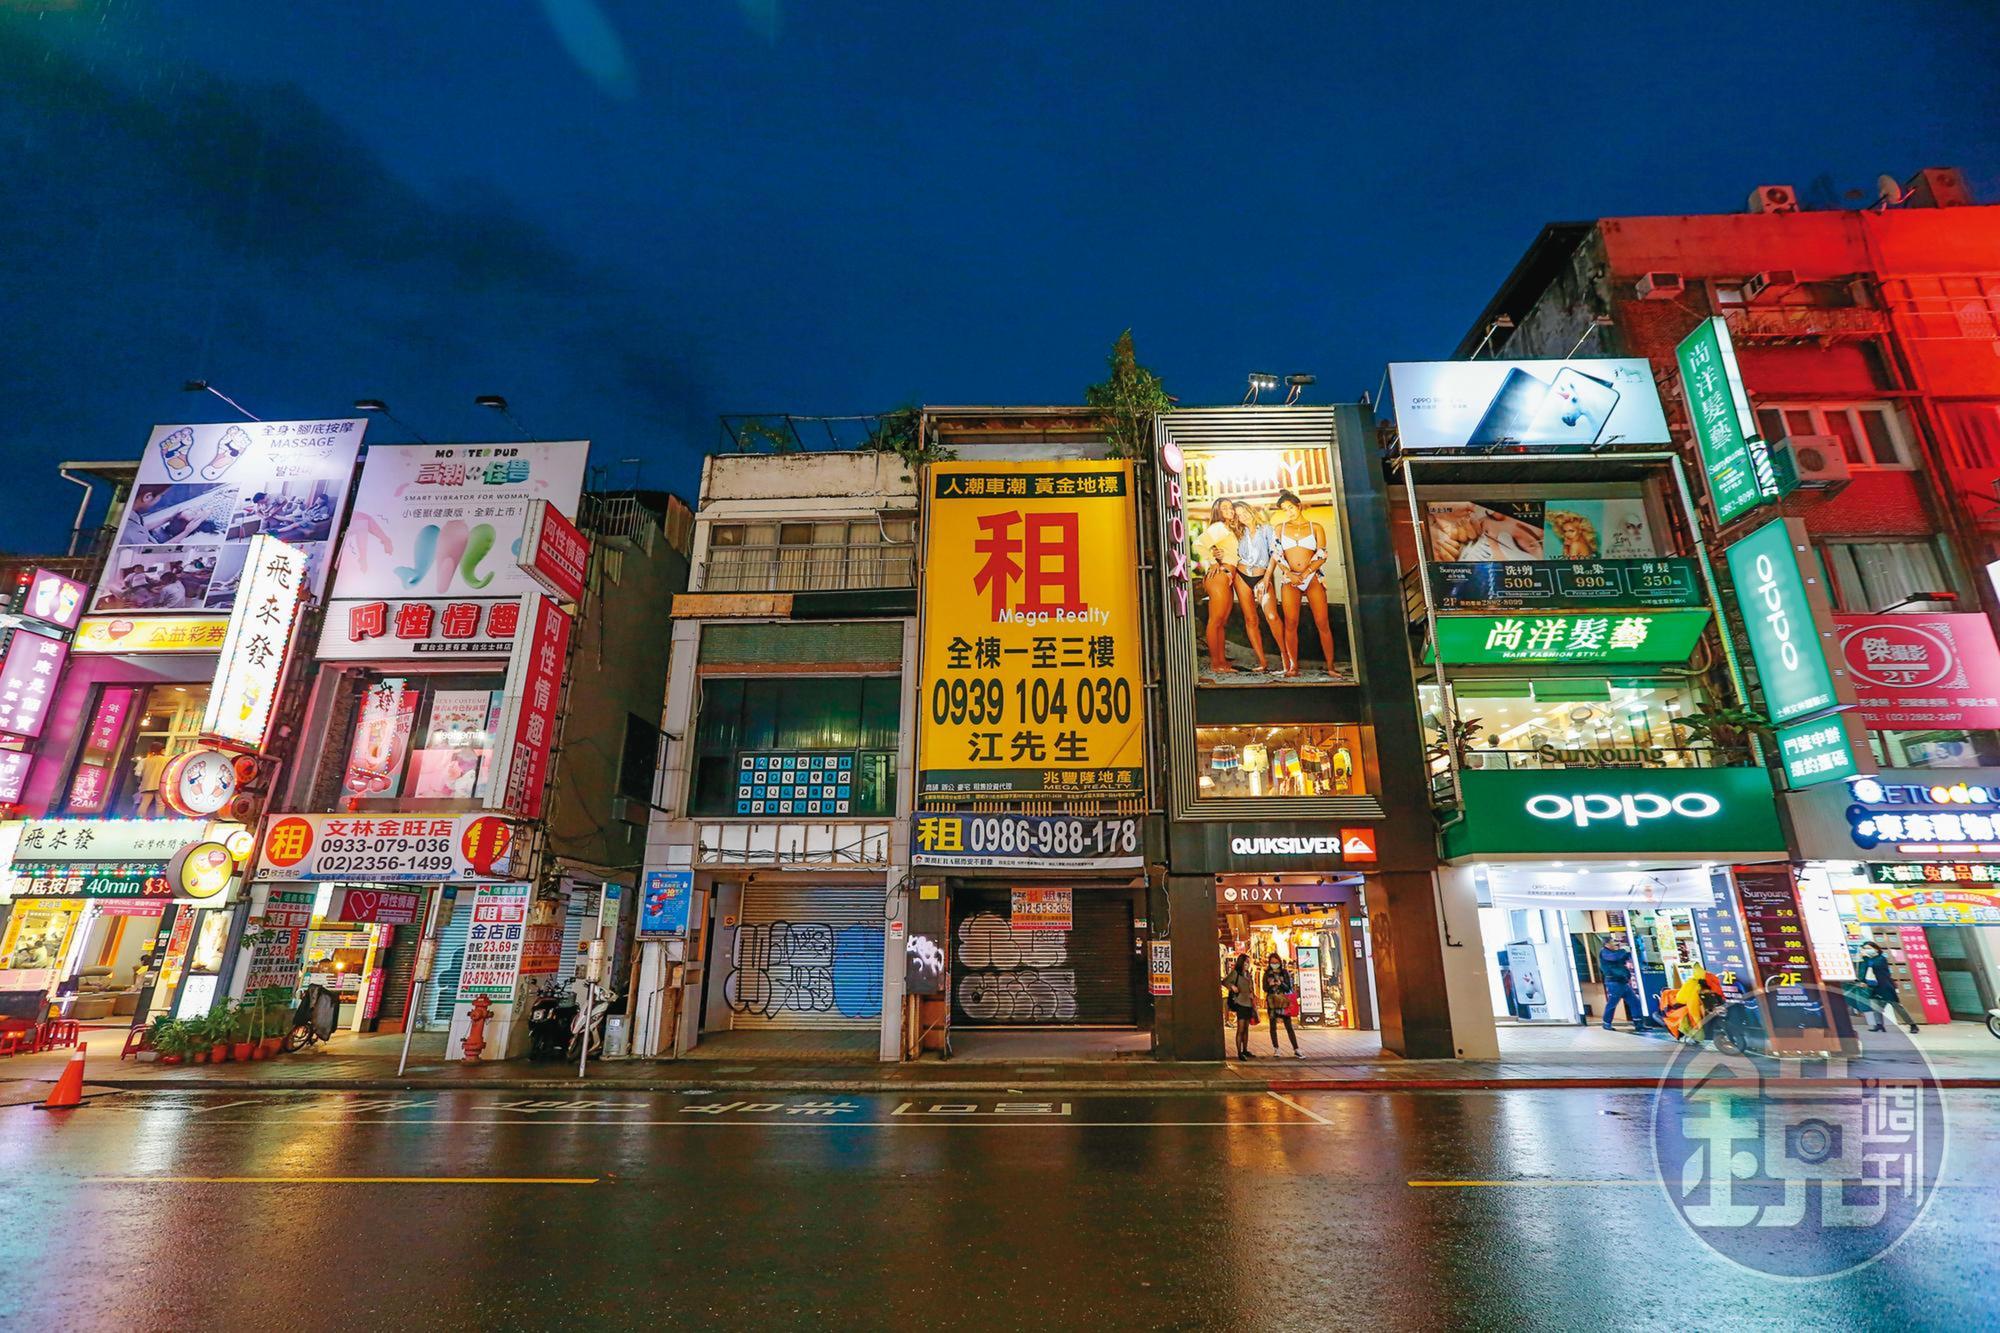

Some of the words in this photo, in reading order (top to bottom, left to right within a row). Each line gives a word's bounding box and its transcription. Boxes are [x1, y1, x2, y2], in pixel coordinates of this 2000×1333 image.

[1689, 340, 1732, 449] 尚洋髮藝
[270, 436, 336, 448] MASSAGE
[494, 448, 519, 457] PUB
[943, 477, 1027, 495] 人潮車潮
[1034, 476, 1119, 495] 黃金地標
[1167, 481, 1188, 618] ROXY
[973, 510, 1088, 622] 租
[1504, 578, 1533, 588] 500
[1575, 576, 1605, 588] 990
[1642, 576, 1673, 586] 350
[245, 555, 293, 669] 飛來發
[998, 608, 1049, 627] Mega
[1056, 607, 1110, 626] Realty
[349, 601, 519, 642] 阿性情趣
[150, 624, 226, 643] 公益彩券
[1485, 617, 1653, 650] 尚洋髮藝
[947, 635, 1115, 669] 全棟一至三樓
[525, 607, 563, 747] 阿性情趣
[1883, 671, 1920, 683] 2F
[932, 677, 1004, 725] 0939
[1016, 677, 1068, 724] 104
[1077, 677, 1131, 724] 030
[967, 730, 1090, 762] 江先生
[1539, 744, 1664, 767] Sunyoung
[1043, 770, 1132, 785] 兆豐隆地產
[324, 820, 454, 837] 文林金旺店
[917, 816, 964, 851] 租
[970, 817, 1137, 854] 0986-988-178
[25, 827, 96, 851] 飛來發
[271, 824, 307, 860] 租
[320, 839, 450, 853] 0933-079-036
[1231, 837, 1341, 855] QUIKSILVER
[316, 856, 452, 873] (02)2356-1499
[86, 877, 140, 894] 40min
[1240, 888, 1283, 901] ROXY
[1743, 888, 1791, 901] Sunyoung
[471, 924, 522, 939] 金店面
[462, 971, 514, 984] 02-8792-7171
[1779, 972, 1801, 987] 2F
